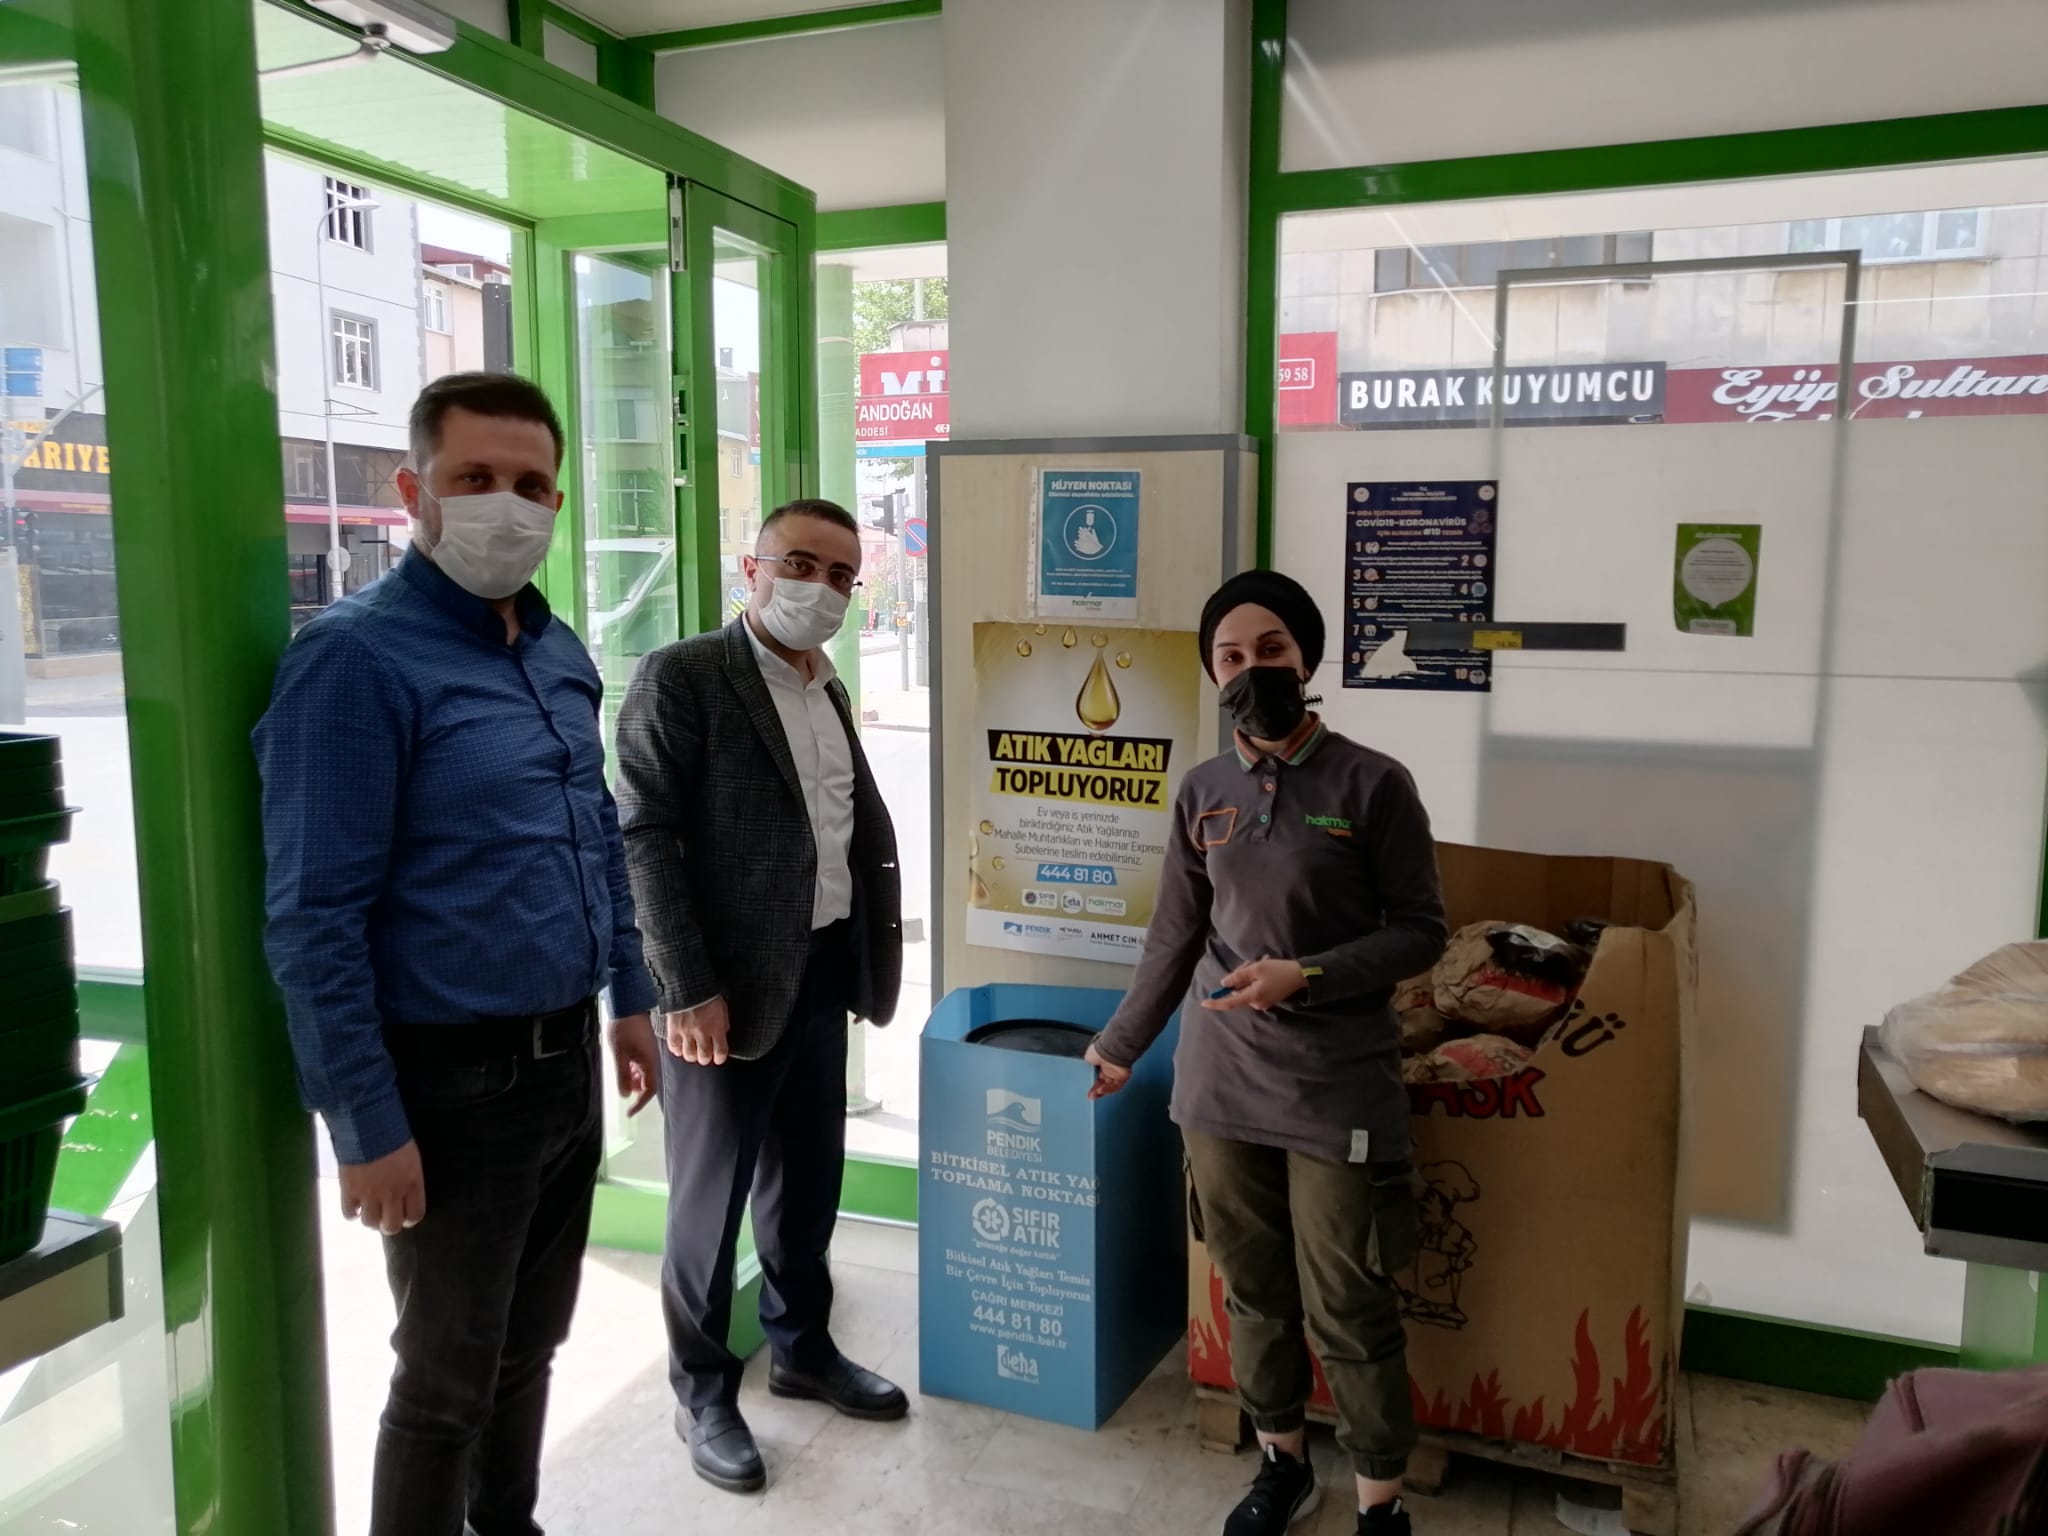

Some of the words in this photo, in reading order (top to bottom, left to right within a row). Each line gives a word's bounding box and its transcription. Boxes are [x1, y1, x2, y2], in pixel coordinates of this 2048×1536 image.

[1294, 367, 1308, 382] 58
[1350, 376, 1465, 409] BURAK
[1477, 369, 1655, 407] KUYUMCU
[1712, 369, 1839, 413] Eyüp
[1858, 364, 2048, 400] Sultan
[856, 400, 933, 422] ANDOĞAN
[1051, 479, 1086, 490] HİJYEN
[1088, 481, 1132, 491] NOKTASI
[995, 733, 1053, 762] ATIK
[996, 768, 1160, 805] TOPLUYORUZ
[1037, 806, 1048, 817] Ev
[1050, 810, 1070, 820] veya
[1080, 811, 1120, 824] yerinizde
[1083, 838, 1093, 848] ve
[1095, 837, 1129, 851] Hakmar
[1040, 866, 1071, 880] 444
[1073, 868, 1088, 881] 81
[1093, 870, 1112, 884] 80
[1090, 932, 1121, 942] AHMET
[986, 1130, 1041, 1152] PENDİK
[931, 1151, 1010, 1177] BİTKİSEL
[1016, 1167, 1061, 1186] ATIK
[931, 1168, 1014, 1195] TOPLAMA
[1012, 1207, 1060, 1230] SIFIR
[1014, 1227, 1060, 1249] ATIK
[945, 1249, 986, 1268] Bitkisel
[946, 1265, 963, 1278] Bir
[966, 1268, 998, 1283] Çevre
[971, 1289, 1007, 1306] ÇAĞRI
[1010, 1297, 1064, 1317] MERKEZİ
[973, 1305, 1006, 1326] 444
[1011, 1313, 1032, 1331] 81
[1039, 1318, 1062, 1337] 80
